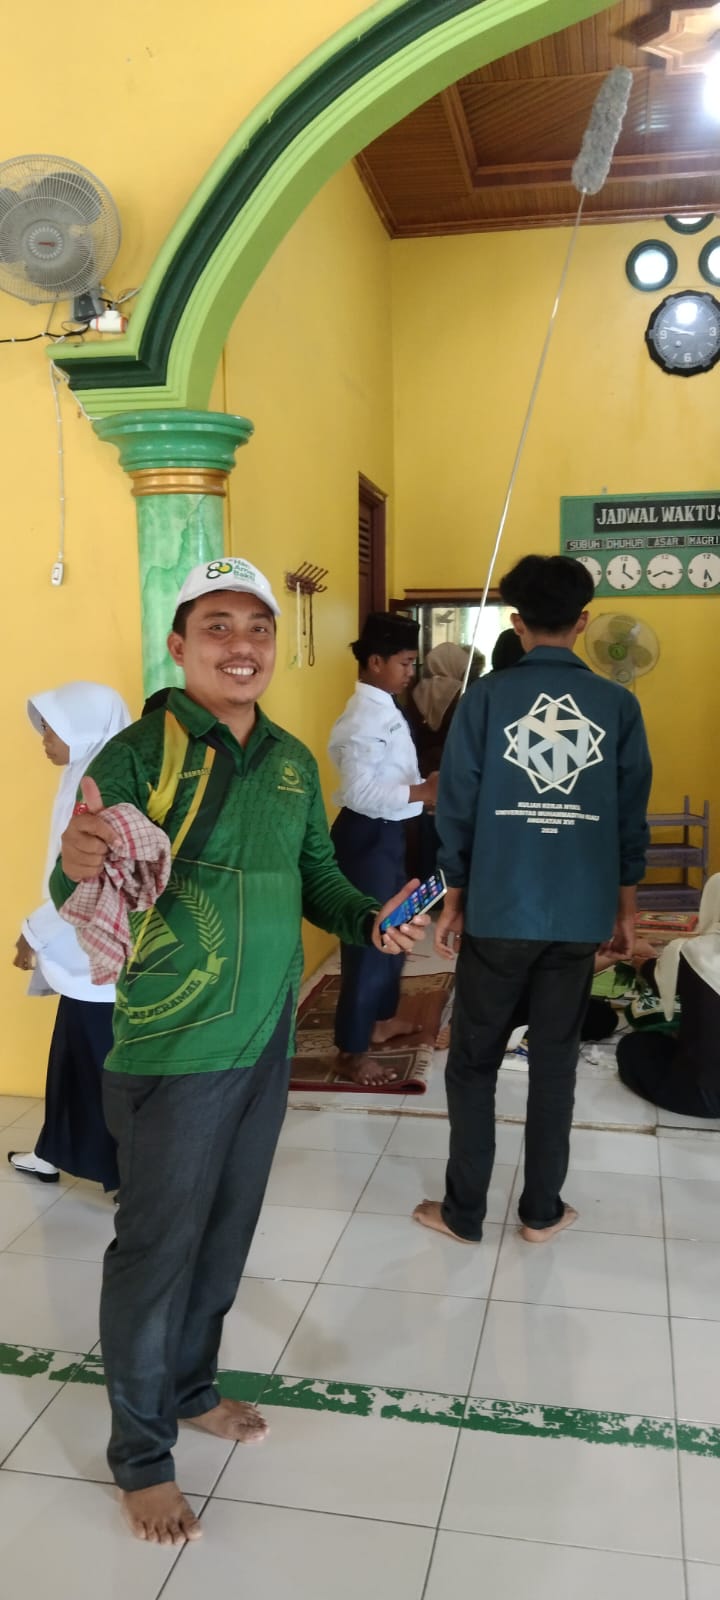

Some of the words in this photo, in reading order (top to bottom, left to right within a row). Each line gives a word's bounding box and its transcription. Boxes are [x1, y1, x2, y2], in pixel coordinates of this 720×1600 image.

[660, 330, 667, 339] 9
[709, 327, 717, 336] 3
[684, 352, 692, 362] 6
[596, 507, 660, 525] JADWAL
[569, 540, 600, 551] SUBUH
[607, 539, 643, 549] DHUHUR
[654, 537, 679, 547] ASAR
